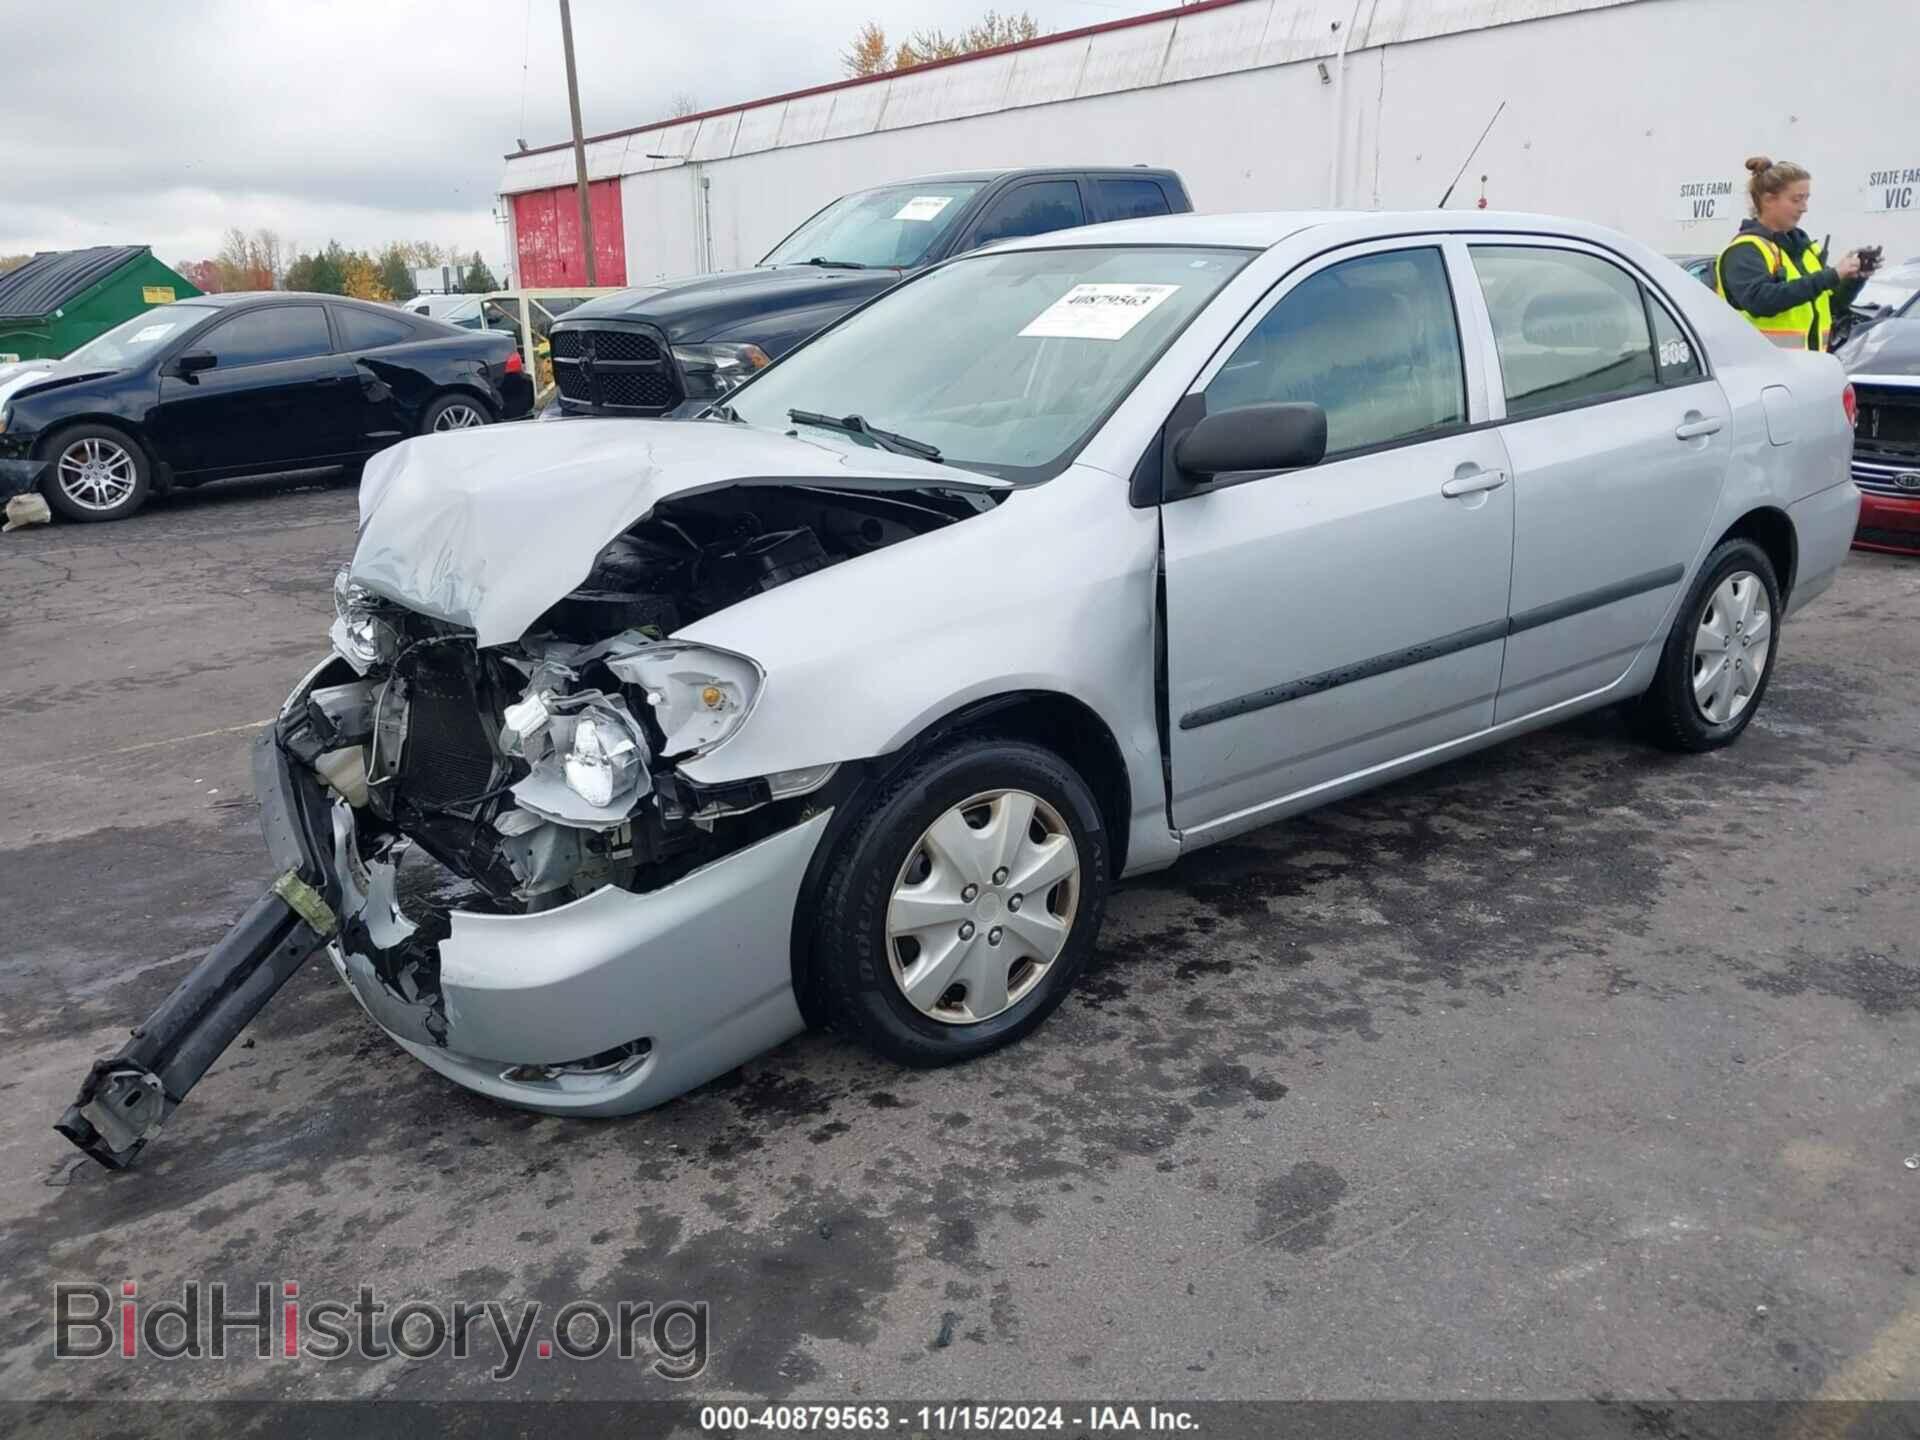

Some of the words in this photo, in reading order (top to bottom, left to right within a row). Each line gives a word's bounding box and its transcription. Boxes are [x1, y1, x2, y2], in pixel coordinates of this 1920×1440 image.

[1870, 170, 1900, 186] STATE
[1680, 183, 1704, 197] STATE
[1706, 181, 1732, 195] FARM
[1886, 187, 1912, 208] VIC
[1694, 199, 1715, 218] VIC
